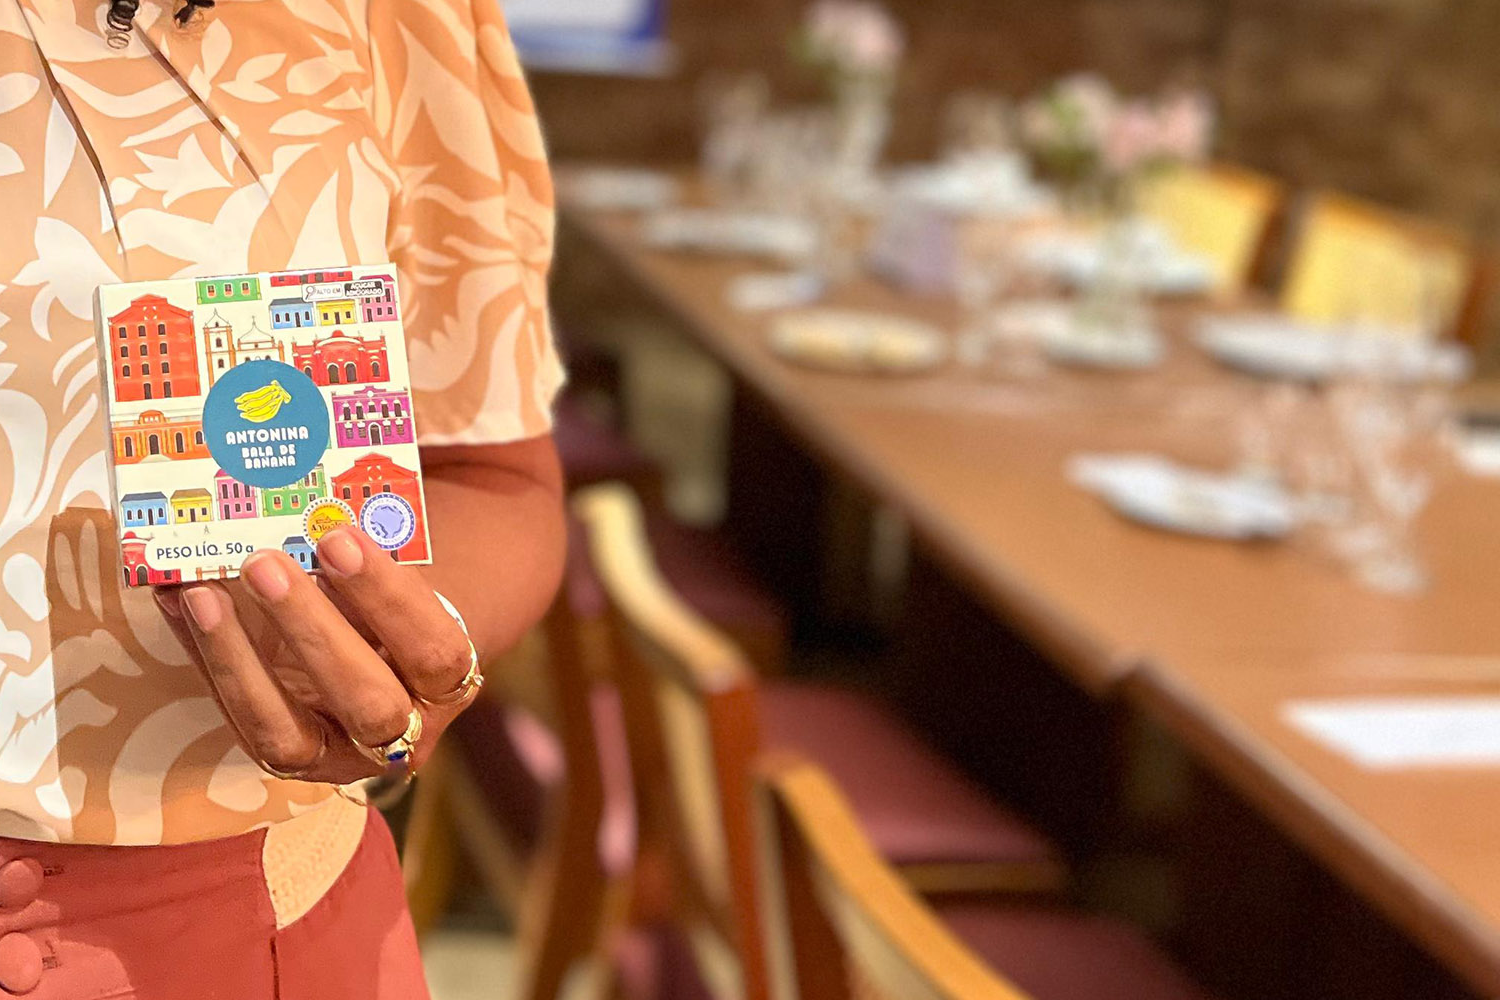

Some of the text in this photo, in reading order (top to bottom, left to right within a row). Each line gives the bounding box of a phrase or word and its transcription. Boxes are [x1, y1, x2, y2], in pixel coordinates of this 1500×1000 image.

[225, 426, 309, 445] ANTONINA
[241, 443, 296, 458] BALA DE
[244, 455, 296, 470] BANANA
[156, 546, 192, 560] PESO
[195, 541, 222, 557] LÍQ.
[226, 542, 243, 555] 50
